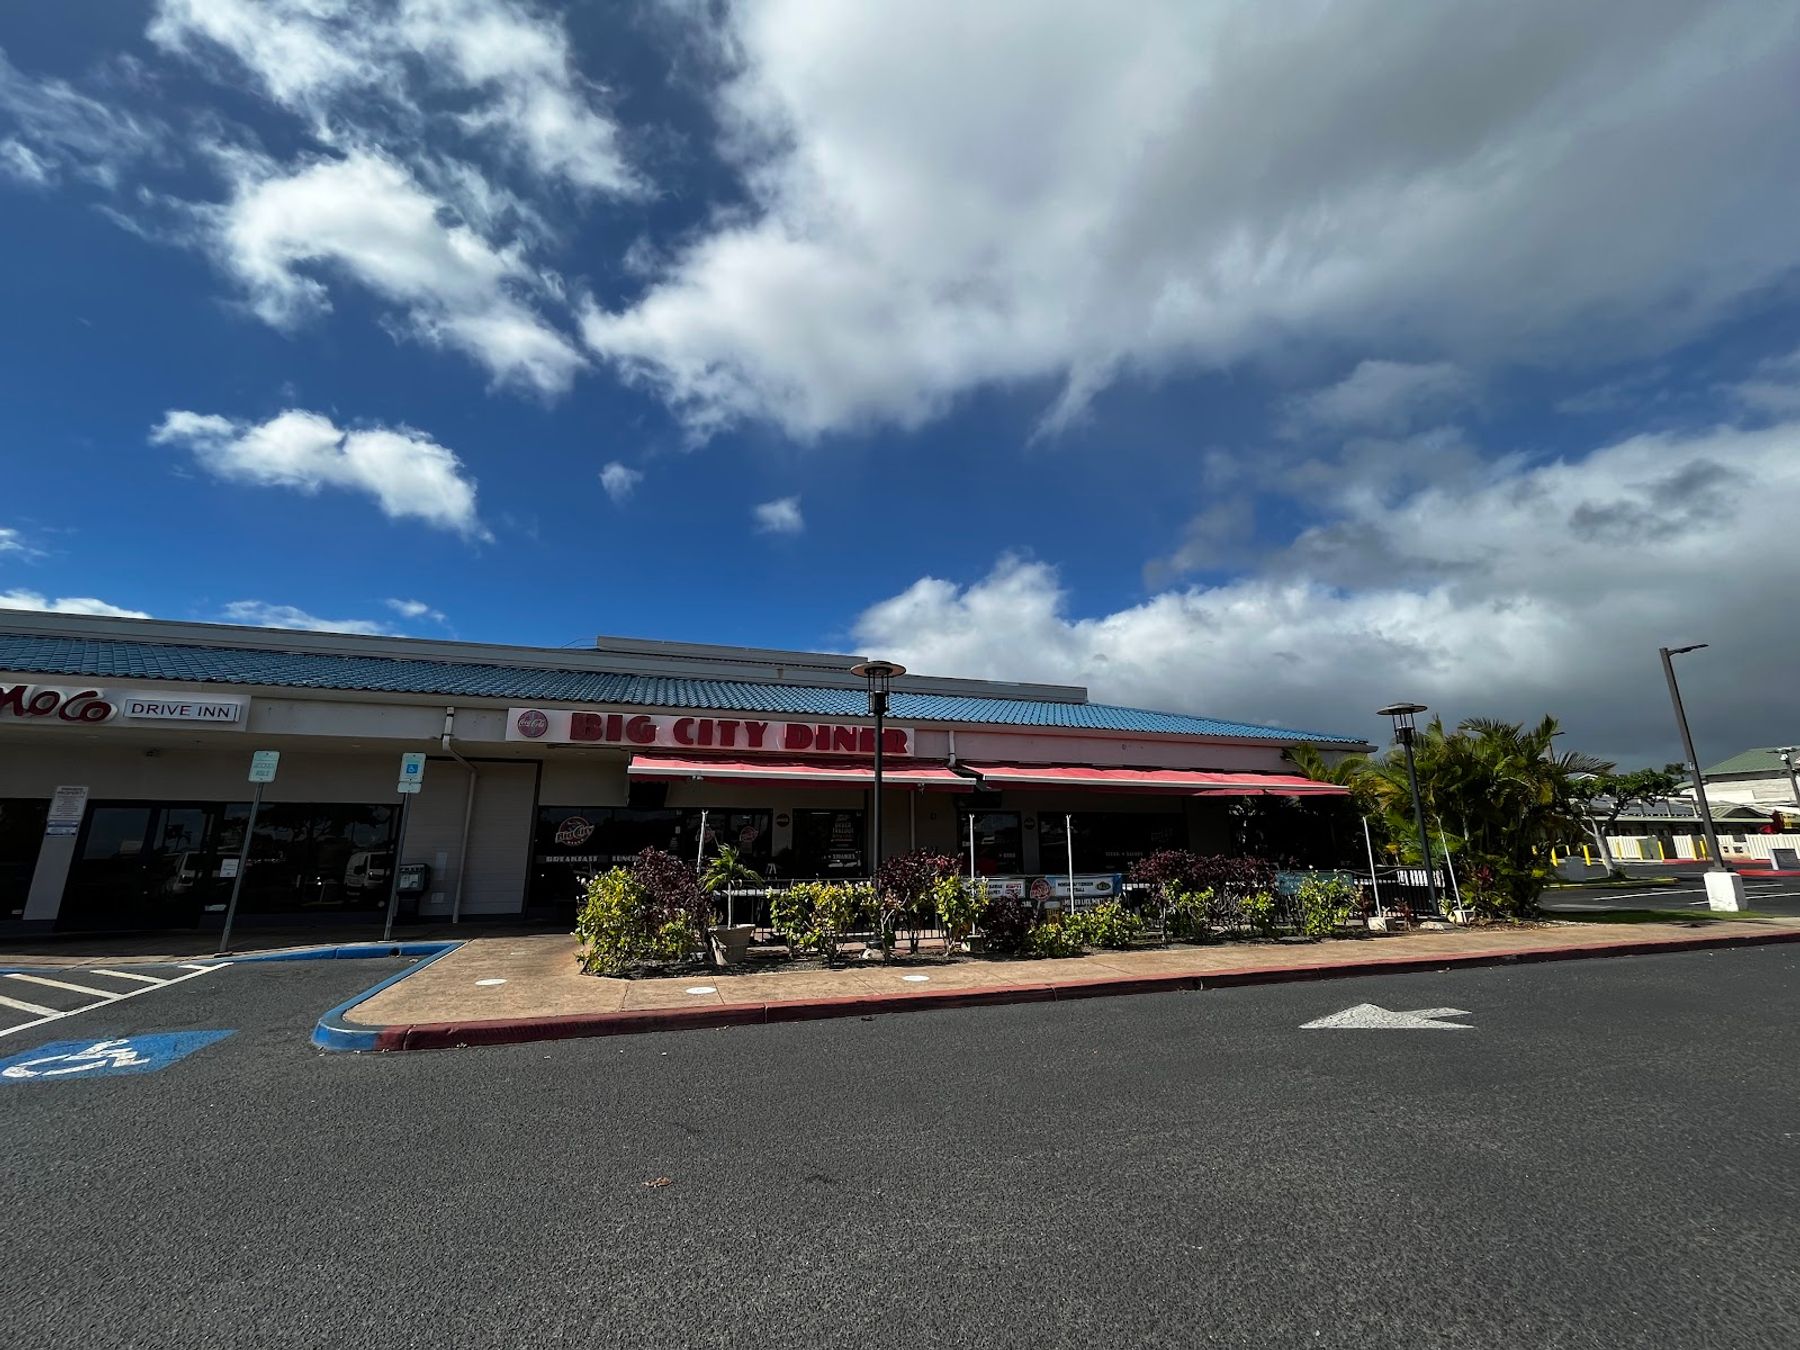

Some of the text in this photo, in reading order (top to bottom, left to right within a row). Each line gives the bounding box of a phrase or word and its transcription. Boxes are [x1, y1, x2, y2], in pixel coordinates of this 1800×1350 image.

[131, 703, 231, 719] DRIVE INN
[570, 712, 908, 754] BIG CITY DINER
